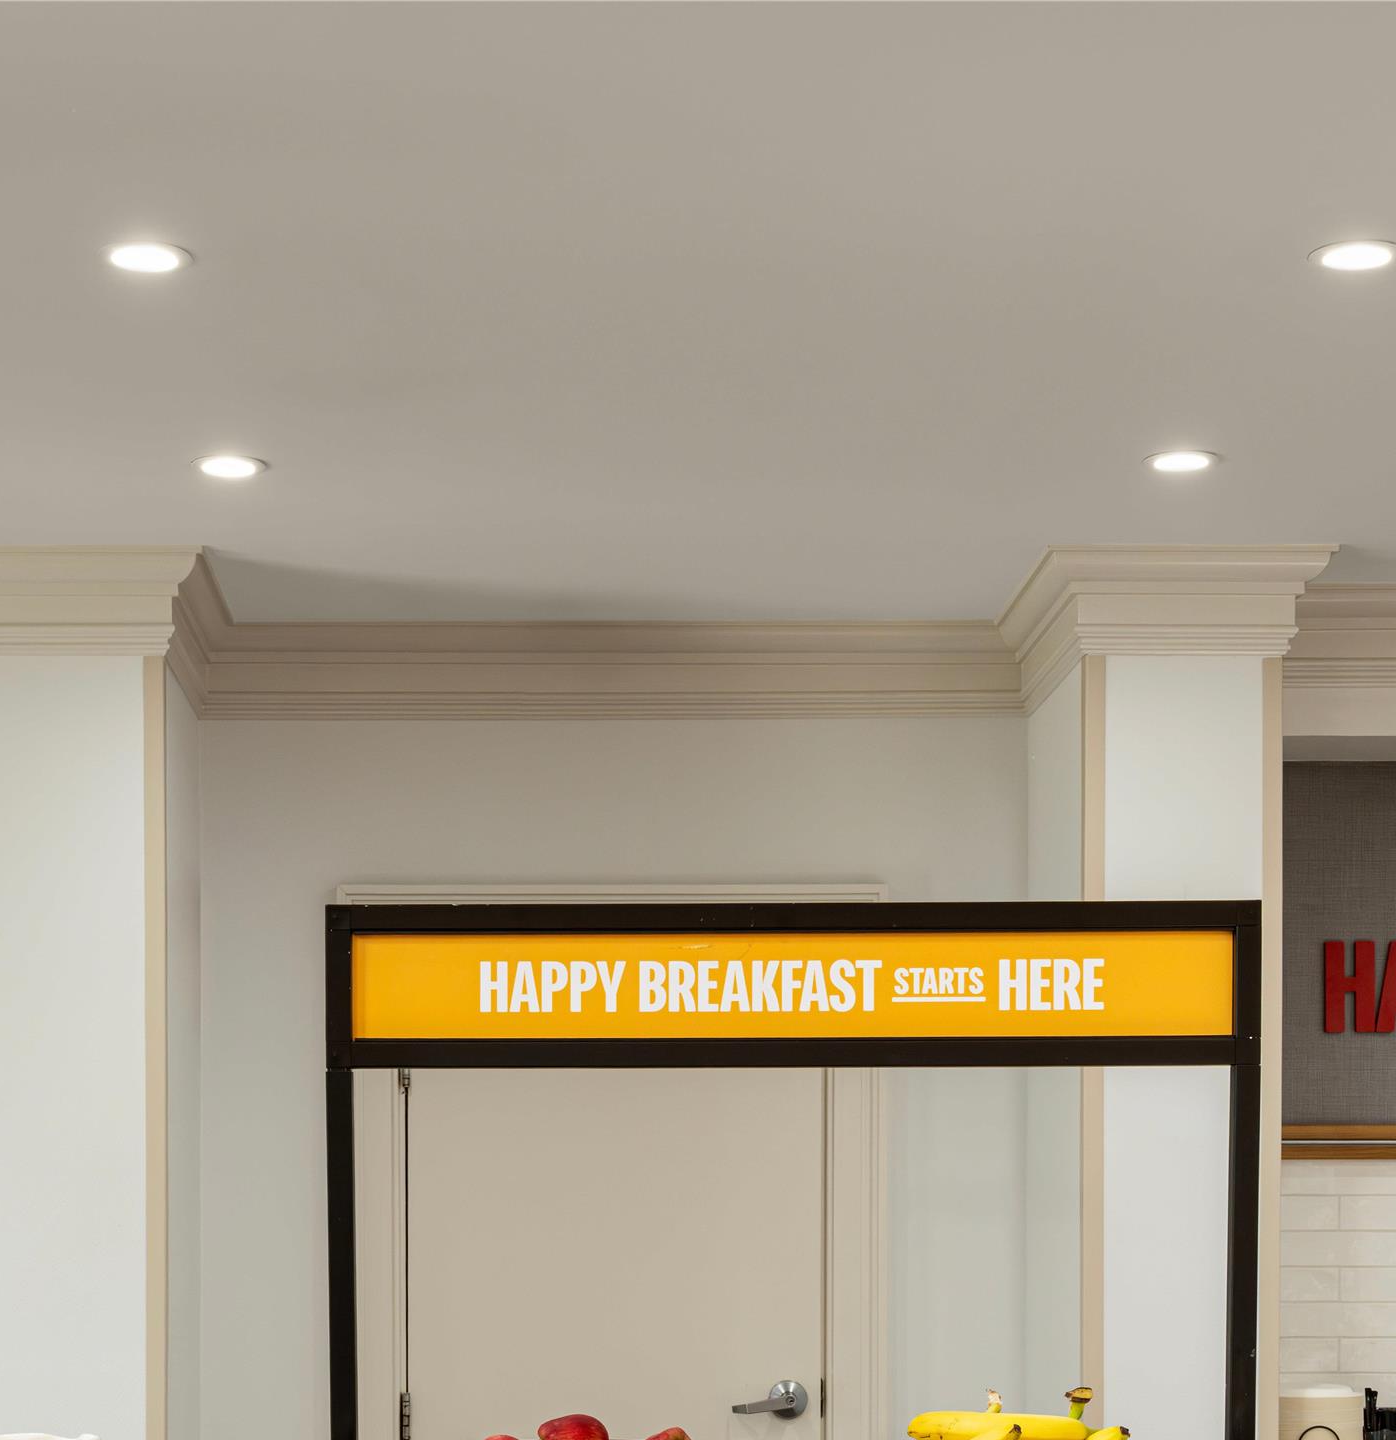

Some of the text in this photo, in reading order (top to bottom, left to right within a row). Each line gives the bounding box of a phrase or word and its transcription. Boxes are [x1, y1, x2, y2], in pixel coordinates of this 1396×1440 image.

[479, 958, 1105, 1013] HAPPY BREAKFAST STARTS HERE
